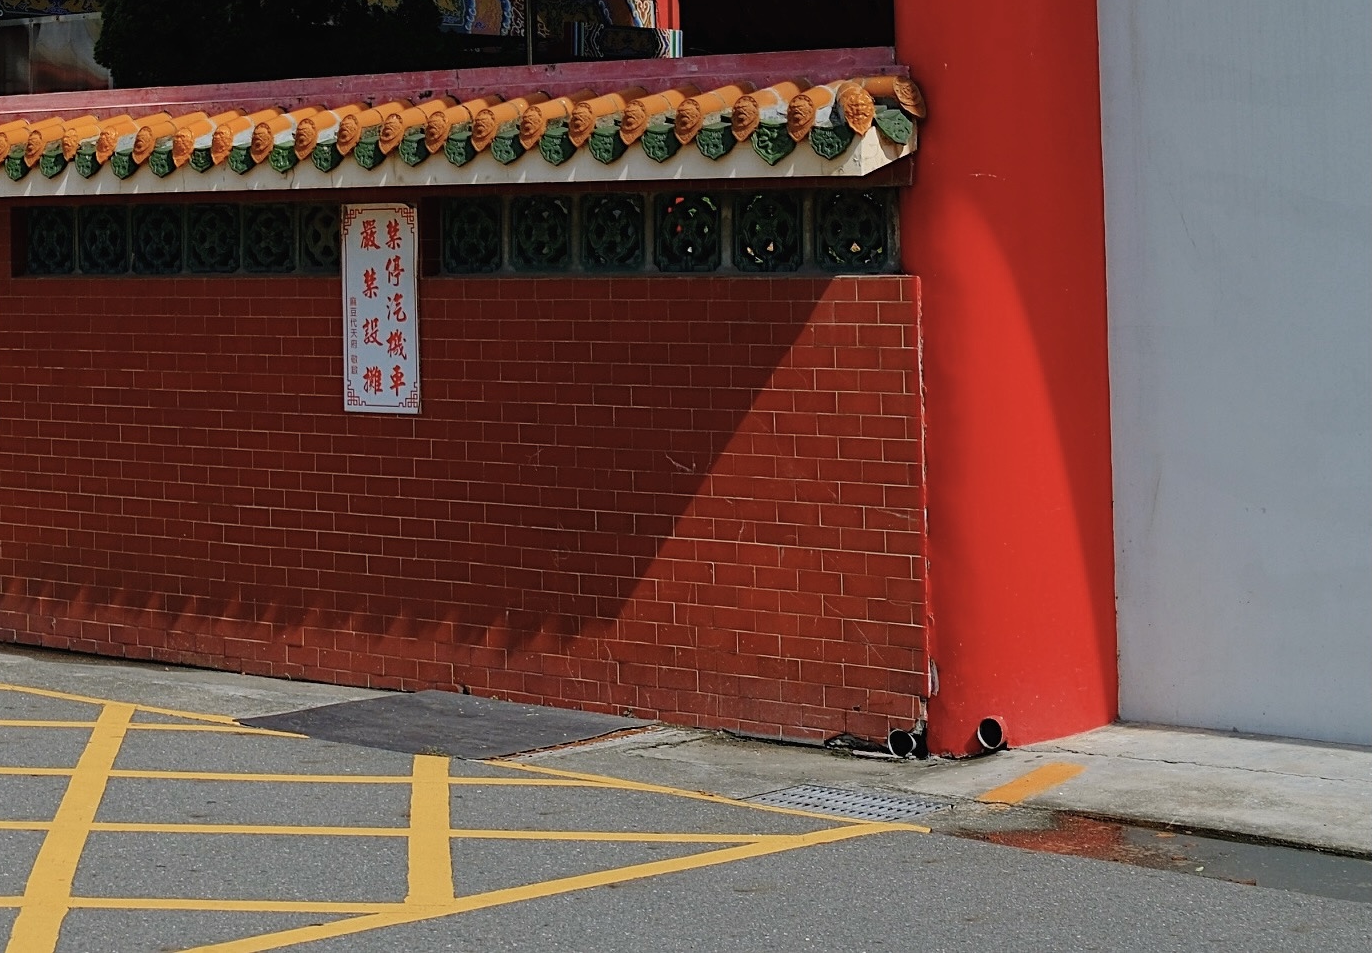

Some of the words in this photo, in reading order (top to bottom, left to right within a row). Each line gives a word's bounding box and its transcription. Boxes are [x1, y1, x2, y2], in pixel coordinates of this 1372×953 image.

[349, 296, 358, 349] 麻豆代天府
[359, 219, 384, 396] 嚴禁設攤
[385, 218, 408, 397] 禁停汽機車
